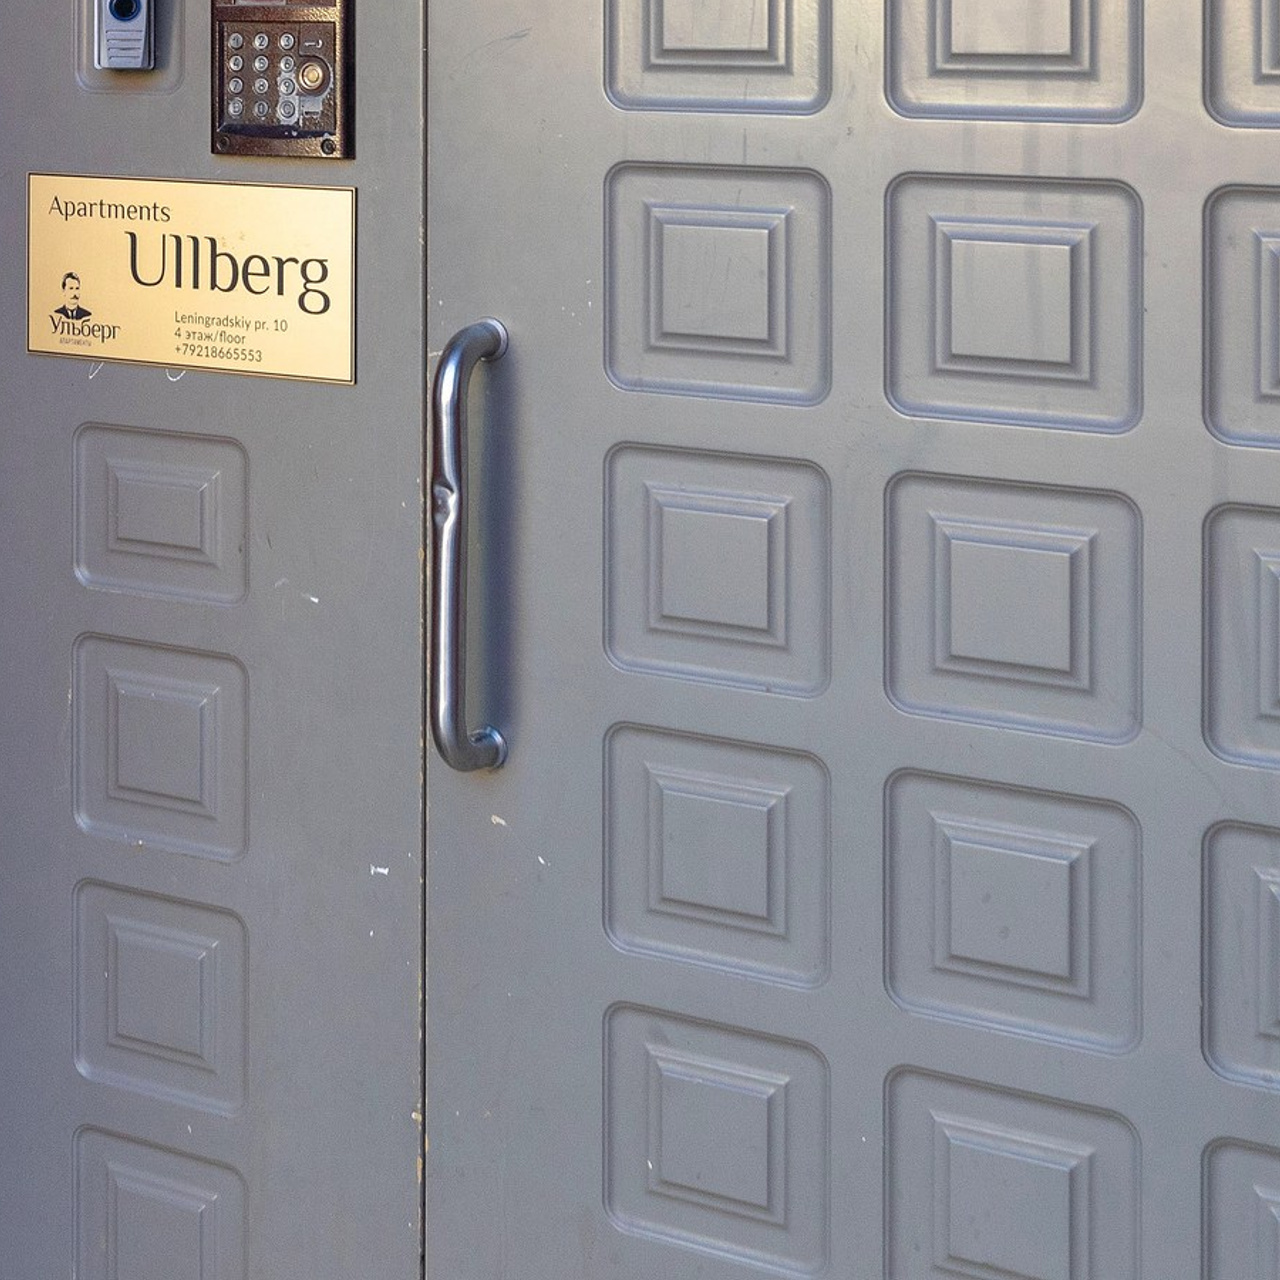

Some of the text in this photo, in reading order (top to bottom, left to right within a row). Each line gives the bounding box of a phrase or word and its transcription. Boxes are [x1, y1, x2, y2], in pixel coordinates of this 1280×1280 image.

[48, 195, 172, 223] Apartments
[124, 231, 332, 316] Ullberg
[48, 314, 122, 344] Ульберг
[174, 310, 288, 332] Leningradskiy pr. 10
[174, 327, 246, 345] 4 этаж/floor
[175, 343, 263, 363] +79218665553
